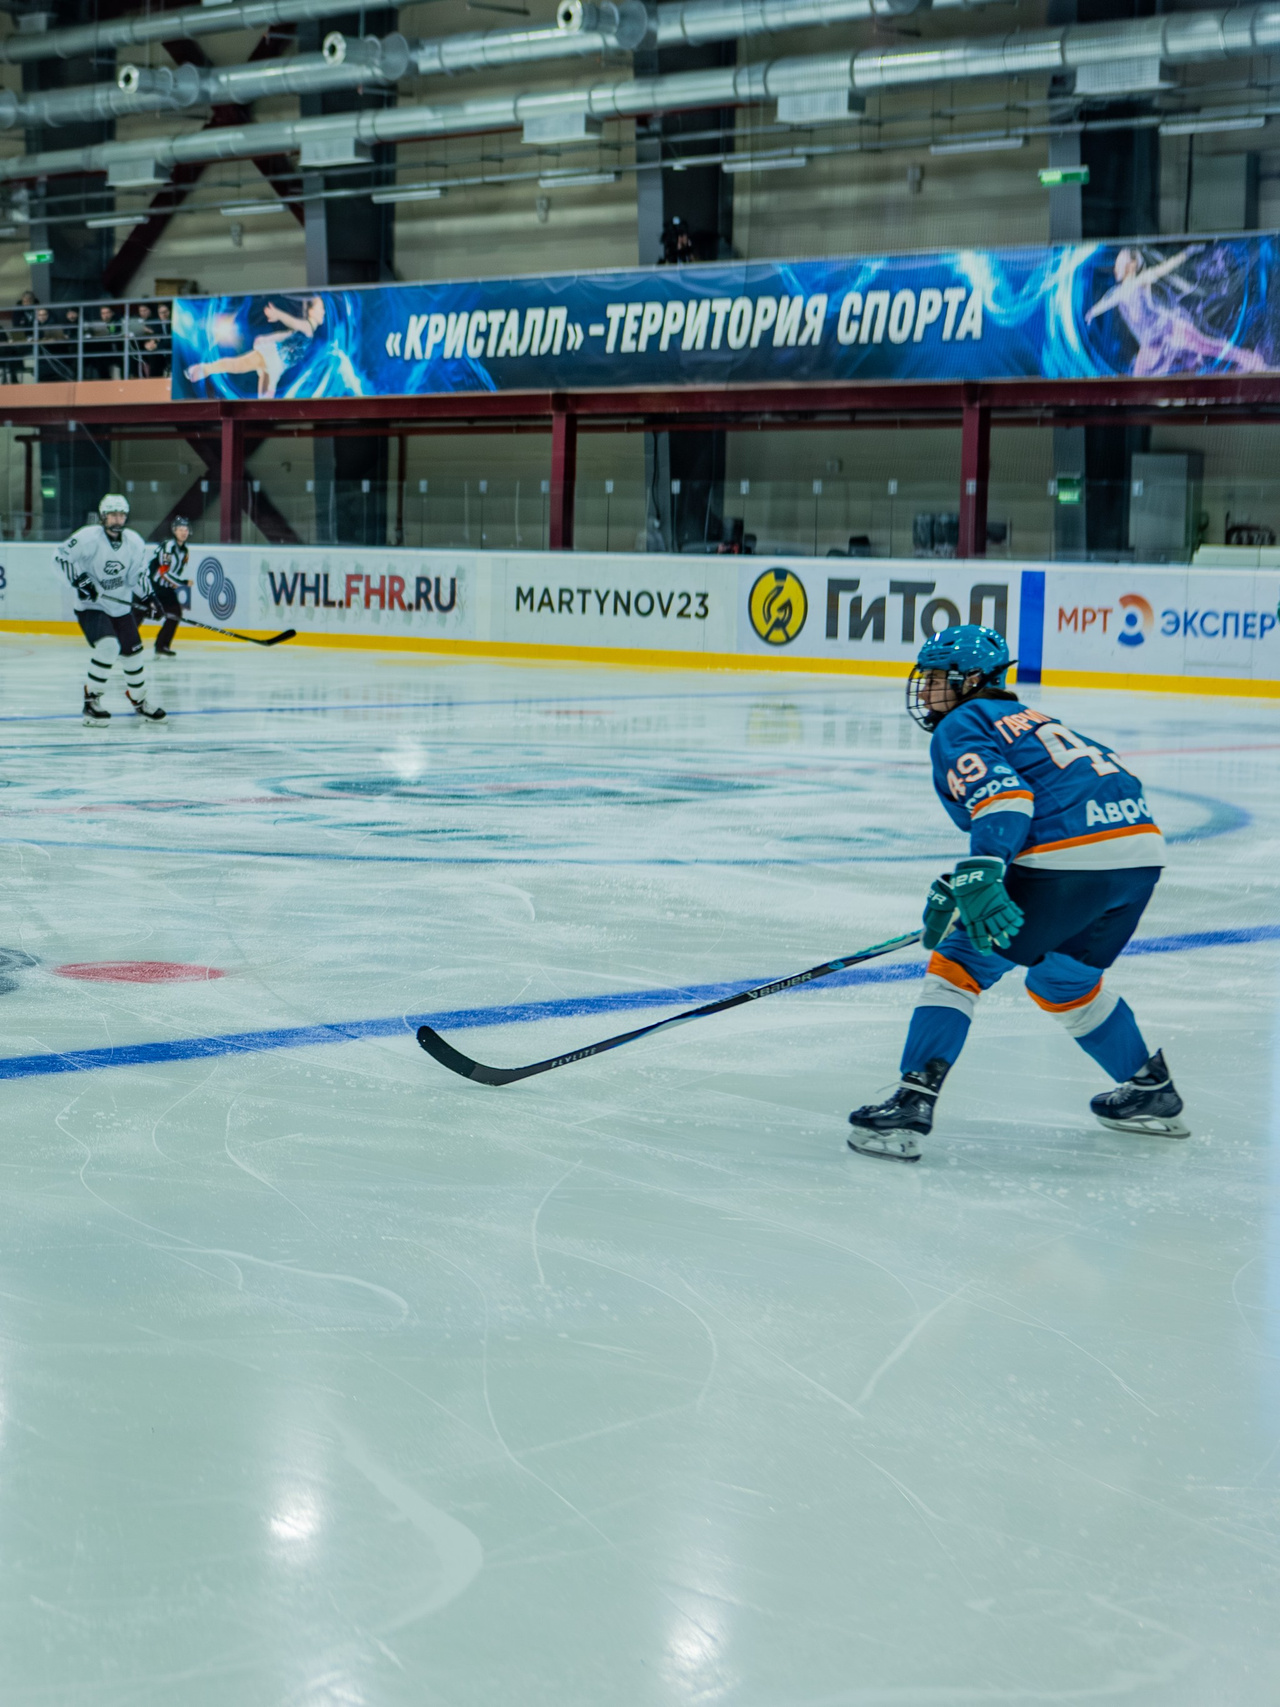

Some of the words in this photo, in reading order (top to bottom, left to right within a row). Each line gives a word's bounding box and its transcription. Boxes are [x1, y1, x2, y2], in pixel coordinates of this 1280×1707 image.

[837, 286, 983, 346] СПОРТА
[268, 571, 457, 613] WHL.FHR.RU
[515, 586, 709, 619] MARTYNOV23
[1058, 606, 1113, 633] МРТ
[1161, 609, 1276, 639] ЭКСПЕР
[947, 752, 988, 800] 49
